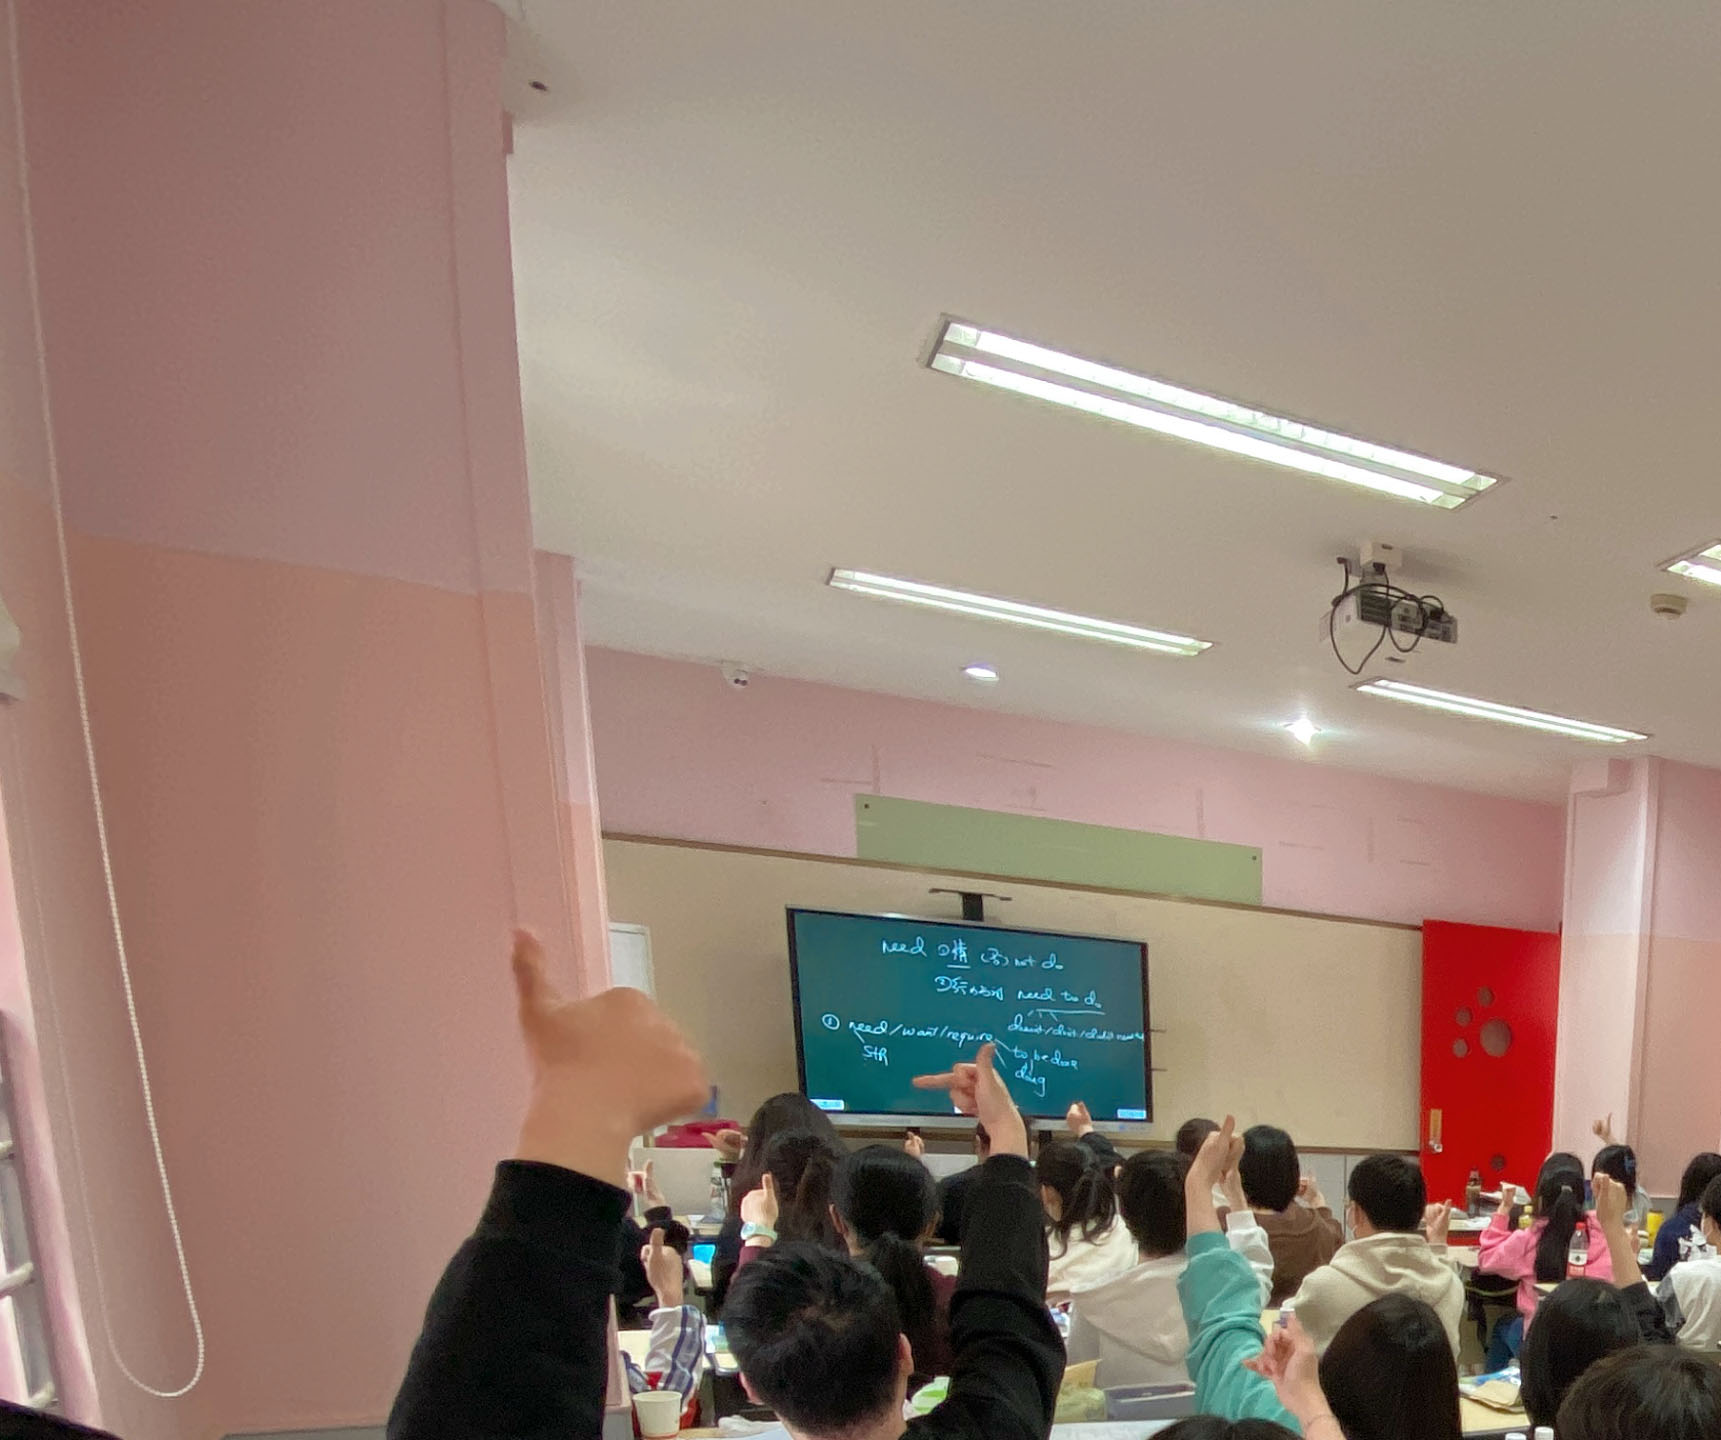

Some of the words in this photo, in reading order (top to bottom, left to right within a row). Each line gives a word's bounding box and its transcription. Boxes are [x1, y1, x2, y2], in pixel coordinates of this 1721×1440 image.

[882, 936, 927, 957] need
[1017, 988, 1056, 1002] need
[1060, 991, 1079, 1003] to
